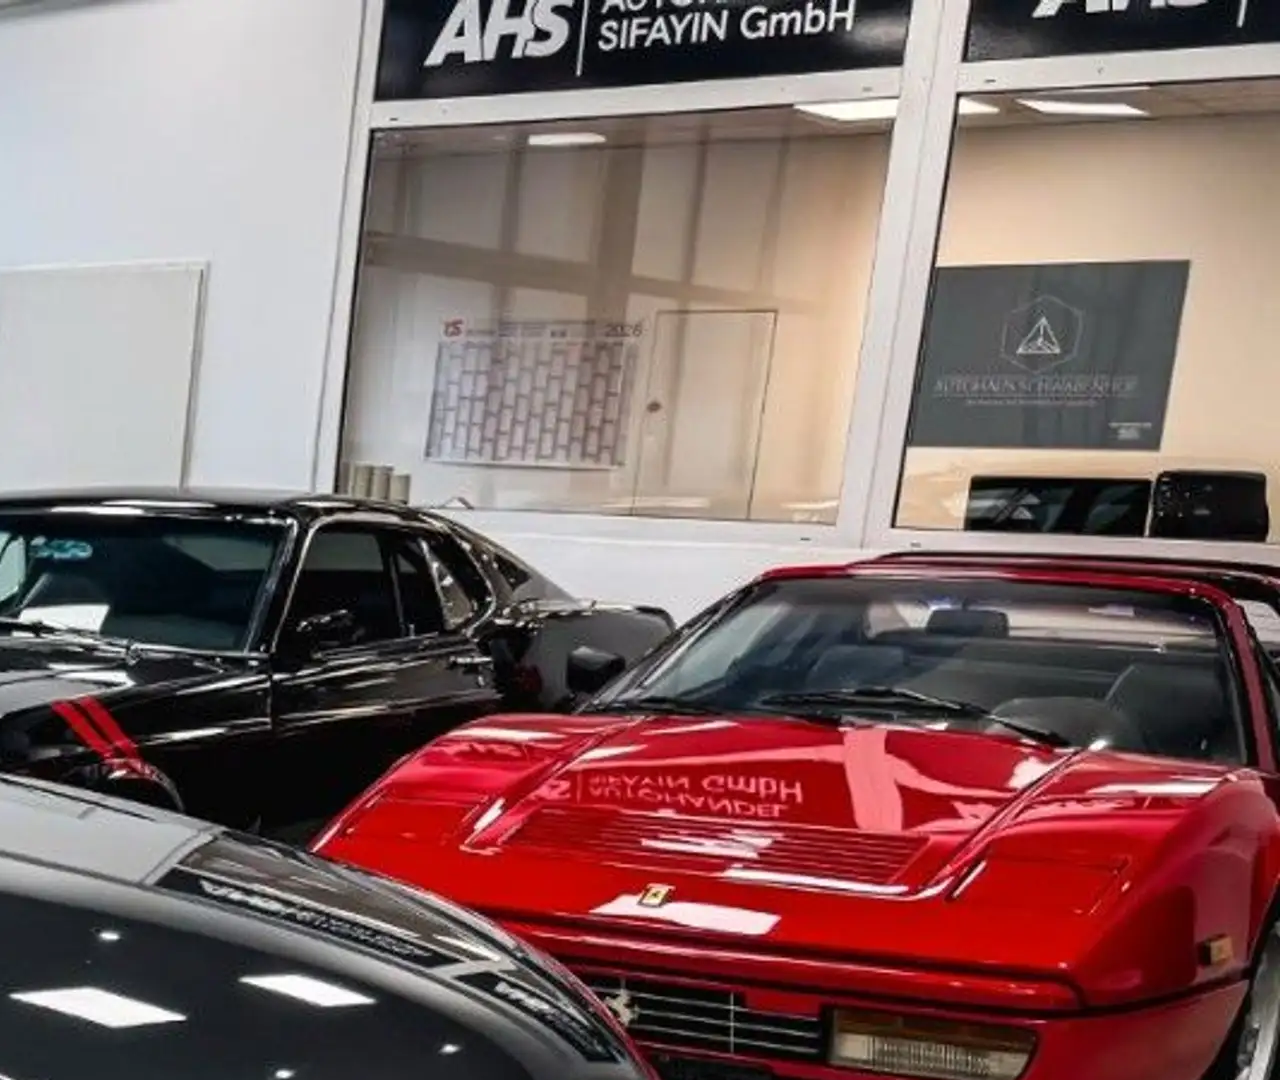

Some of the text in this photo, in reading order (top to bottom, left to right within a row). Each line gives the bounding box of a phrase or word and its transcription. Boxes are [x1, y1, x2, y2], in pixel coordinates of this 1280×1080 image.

[423, 0, 570, 67] AHS
[597, 0, 856, 51] SIFAYIN GmbH
